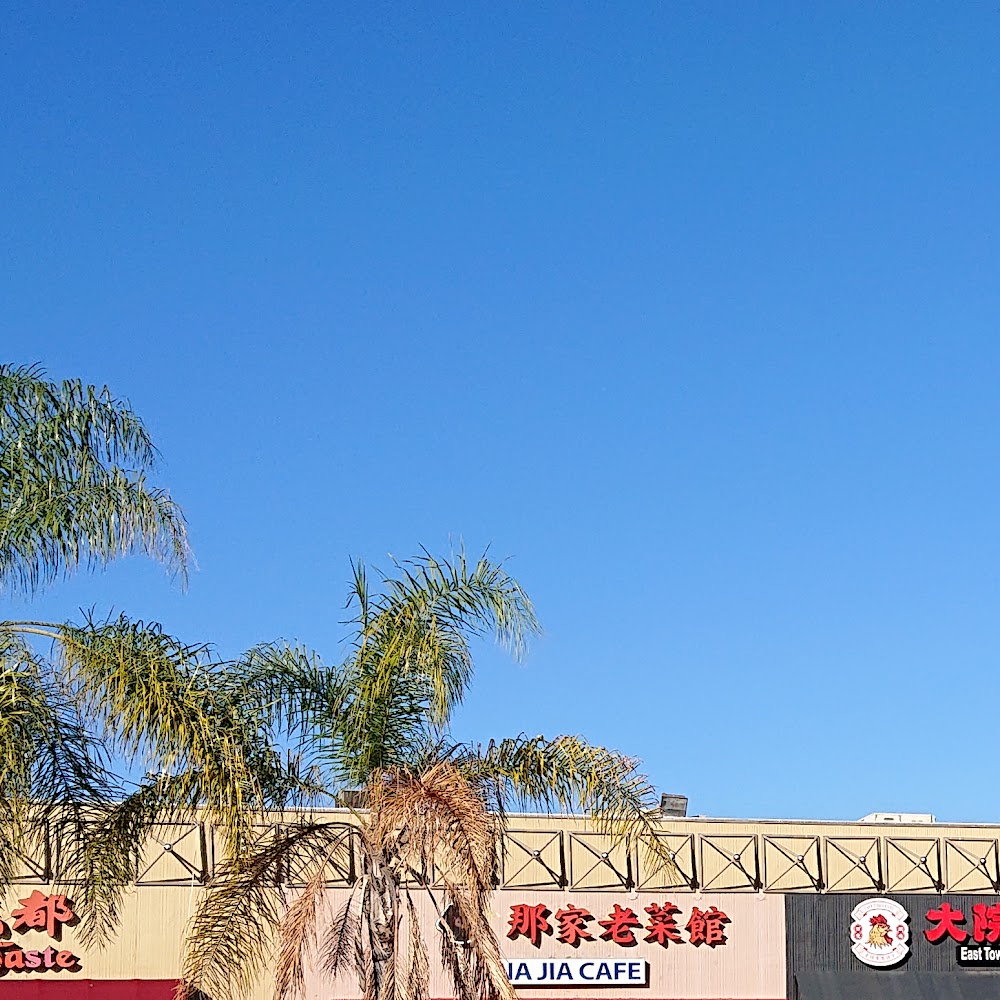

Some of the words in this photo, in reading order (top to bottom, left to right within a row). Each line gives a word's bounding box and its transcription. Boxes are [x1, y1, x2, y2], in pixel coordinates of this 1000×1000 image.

[0, 889, 74, 938] 都
[506, 902, 729, 946] 那家老菜館
[0, 941, 76, 969] aste
[960, 946, 983, 961] East
[537, 962, 574, 981] JIA
[578, 962, 641, 981] CAFE
